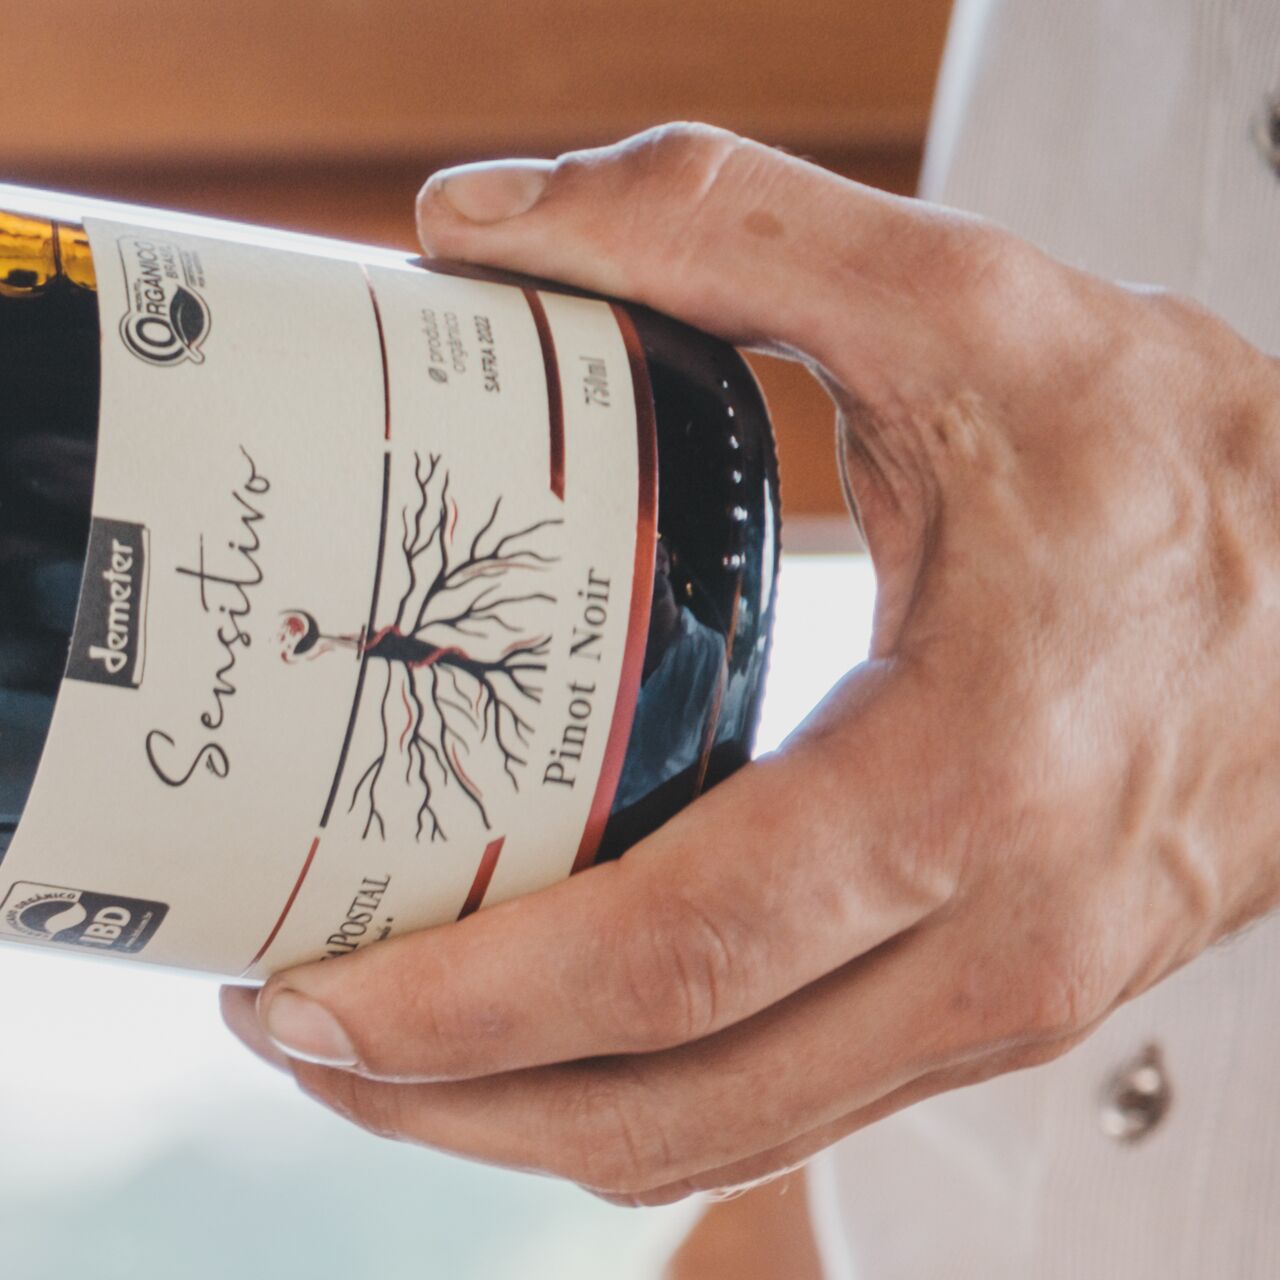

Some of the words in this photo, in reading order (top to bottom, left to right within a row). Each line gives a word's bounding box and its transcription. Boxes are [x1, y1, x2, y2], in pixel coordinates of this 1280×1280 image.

[421, 308, 445, 364] produto
[480, 348, 500, 393] SAFRA
[88, 537, 133, 674] demeter
[145, 443, 271, 788] Sensitivo
[542, 680, 596, 790] Pinot
[569, 566, 611, 662] Noir
[79, 905, 131, 946] IBD
